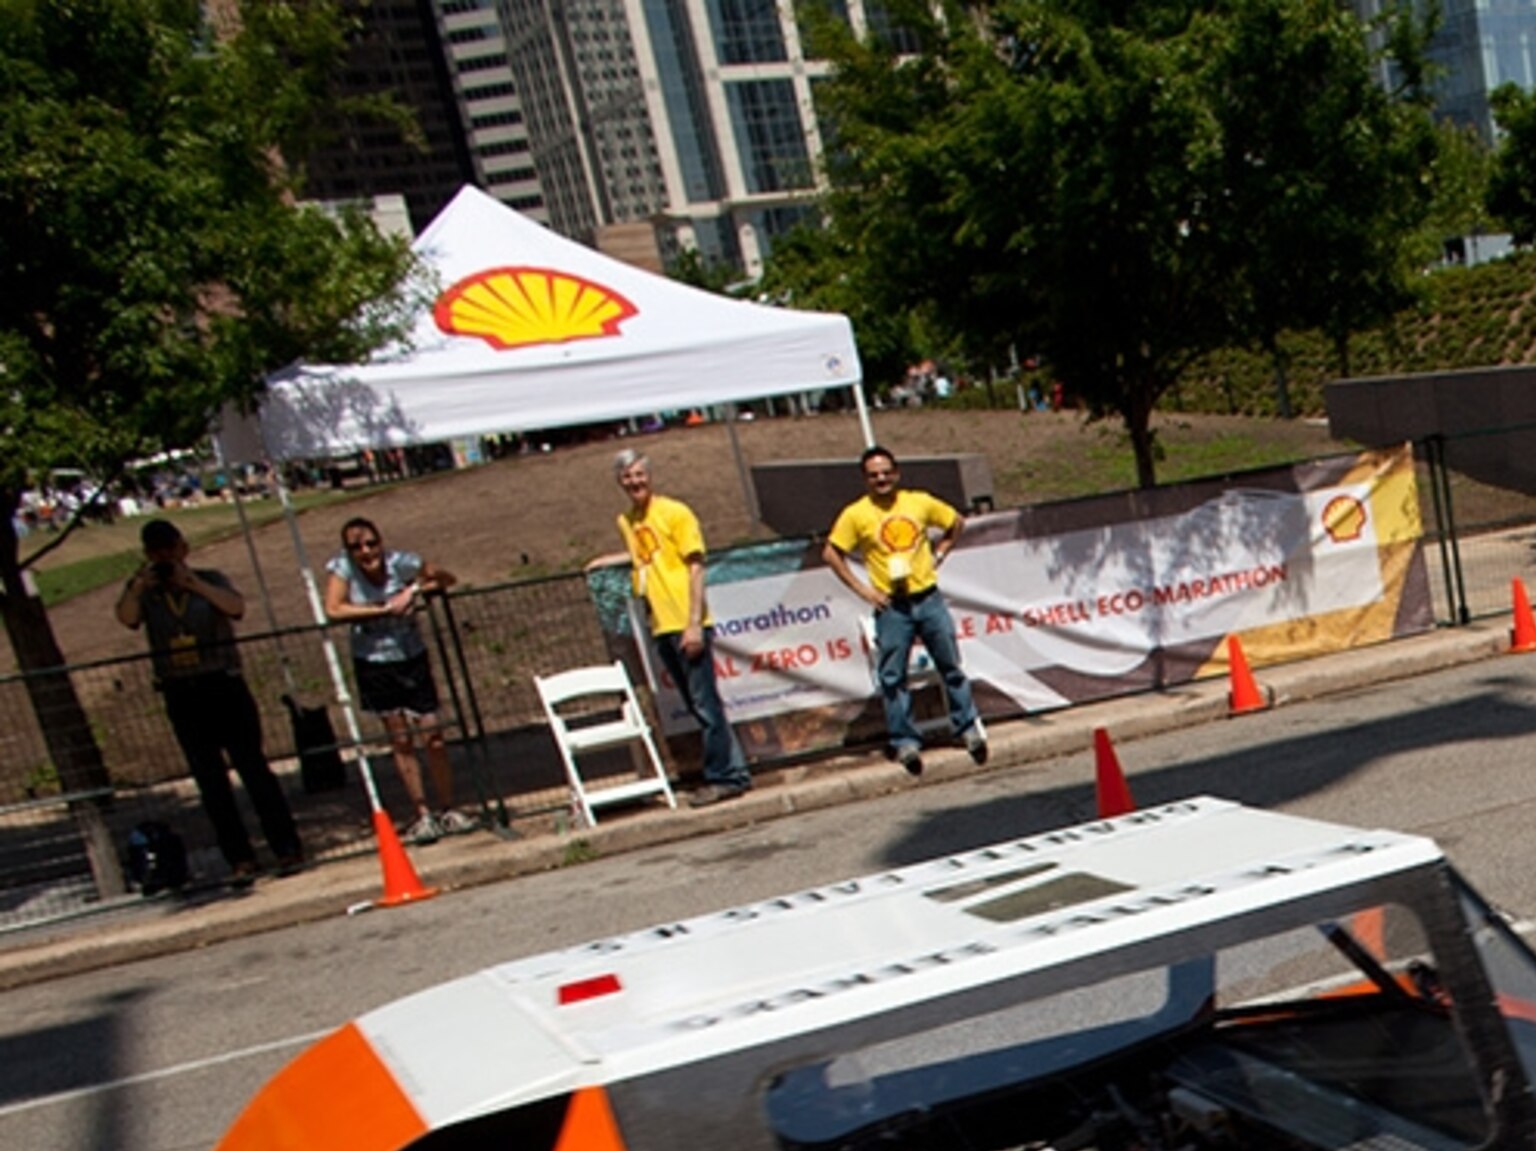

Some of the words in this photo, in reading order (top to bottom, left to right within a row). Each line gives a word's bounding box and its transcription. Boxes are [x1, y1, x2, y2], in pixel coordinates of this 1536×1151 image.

[749, 643, 819, 674] ZERO
[827, 638, 851, 662] IS
[985, 611, 1015, 636] AT
[1024, 598, 1091, 629] SHELL
